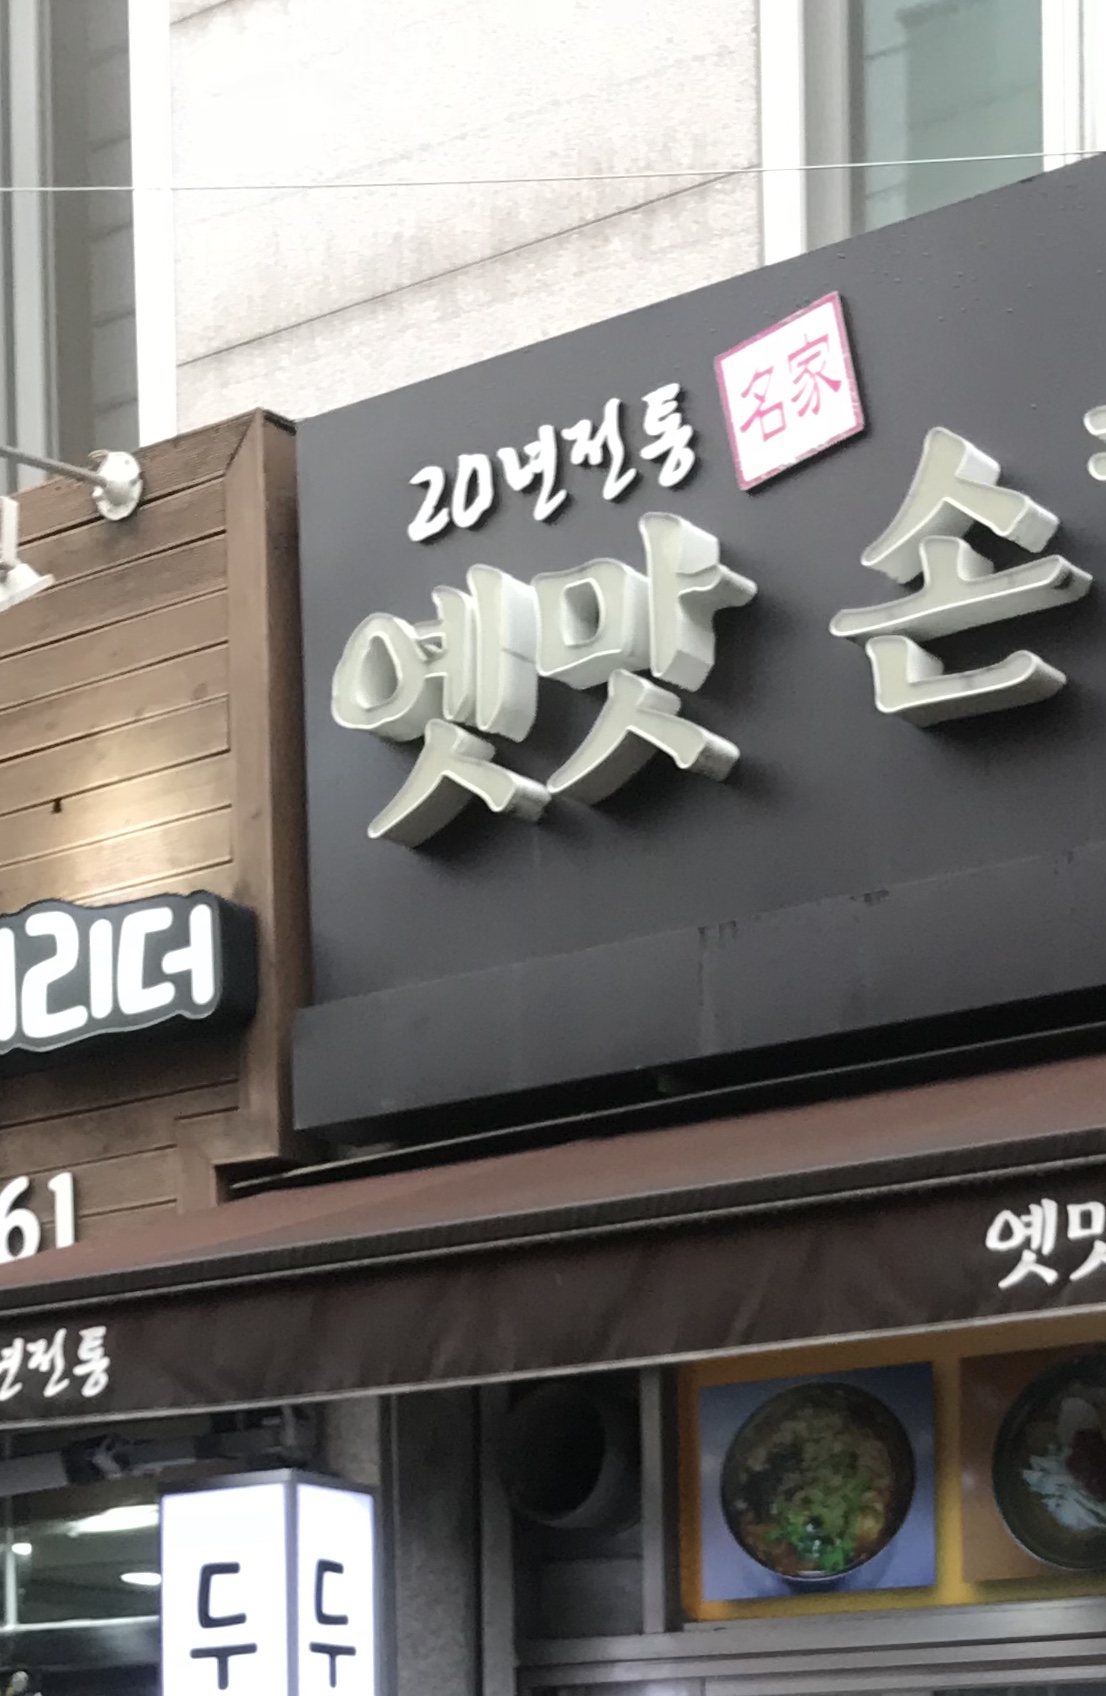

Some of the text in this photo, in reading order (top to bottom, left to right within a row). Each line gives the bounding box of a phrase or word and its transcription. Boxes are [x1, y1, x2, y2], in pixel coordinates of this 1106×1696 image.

[406, 382, 698, 543] 20년전통
[740, 333, 842, 442] 名家
[331, 511, 759, 850] 옛맛
